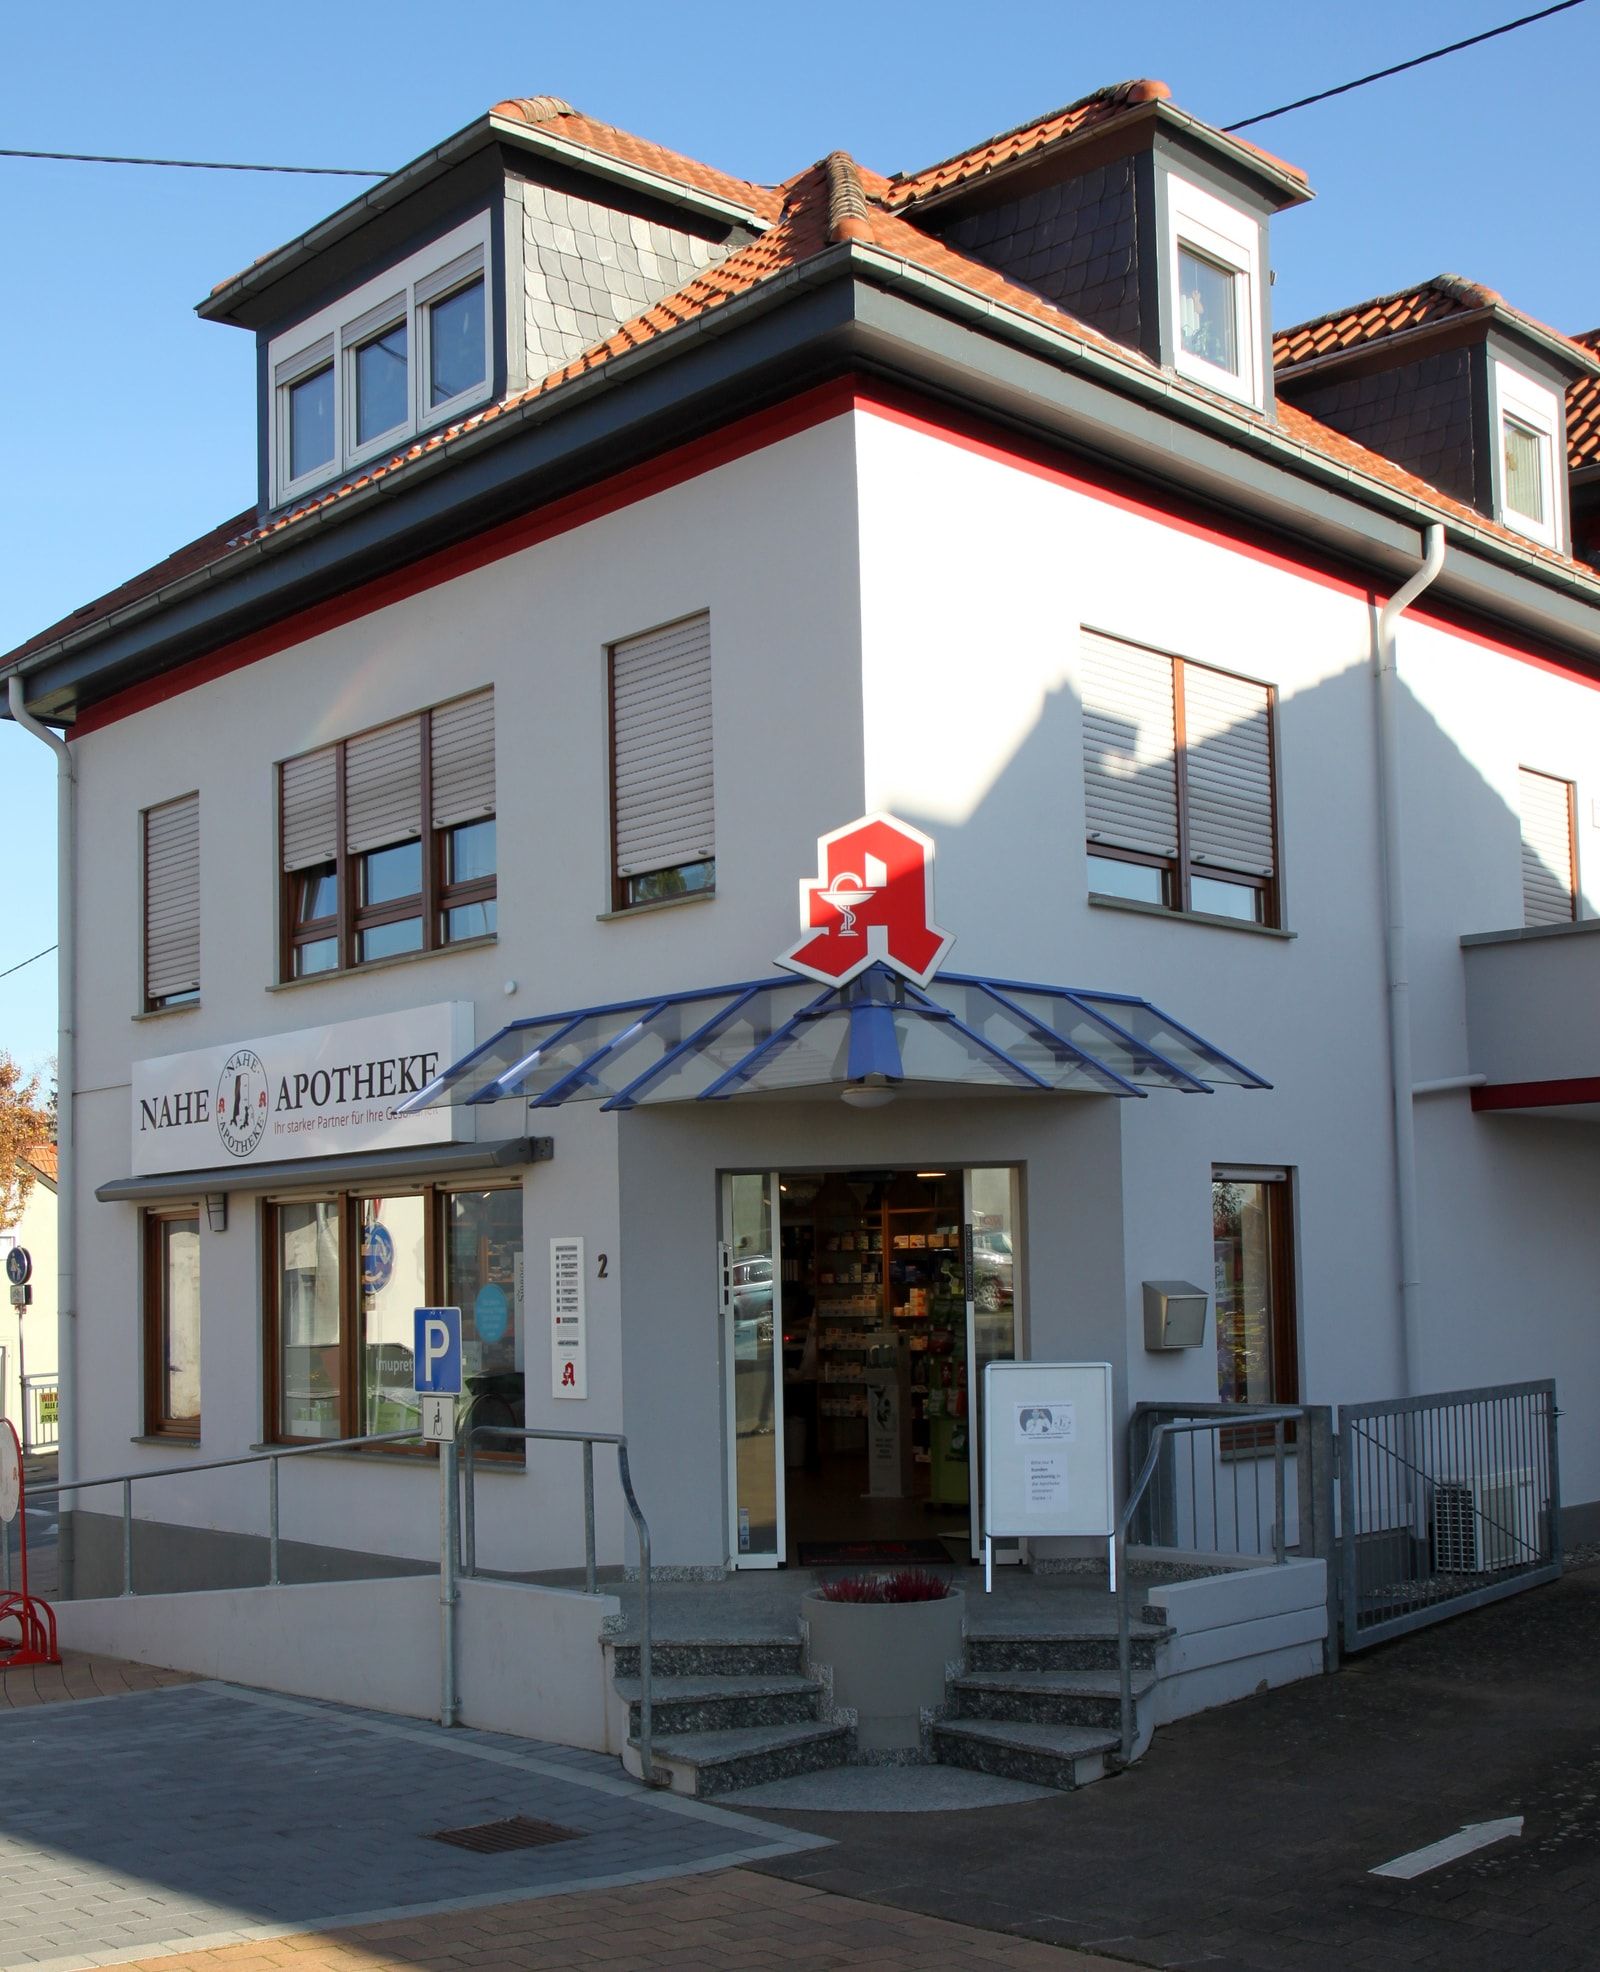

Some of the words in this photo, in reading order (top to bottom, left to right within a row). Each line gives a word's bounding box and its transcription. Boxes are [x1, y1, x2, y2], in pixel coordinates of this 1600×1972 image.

[227, 1053, 259, 1077] NAHE
[139, 1090, 210, 1131] NAHE
[274, 1122, 285, 1135] Ihr
[287, 1117, 315, 1133] starker
[318, 1114, 350, 1130] Partner
[351, 1111, 364, 1126] für
[366, 1109, 388, 1122] Ihre
[220, 1119, 264, 1153] APOTHEKE
[597, 1253, 609, 1279] 2
[424, 1319, 450, 1382] P
